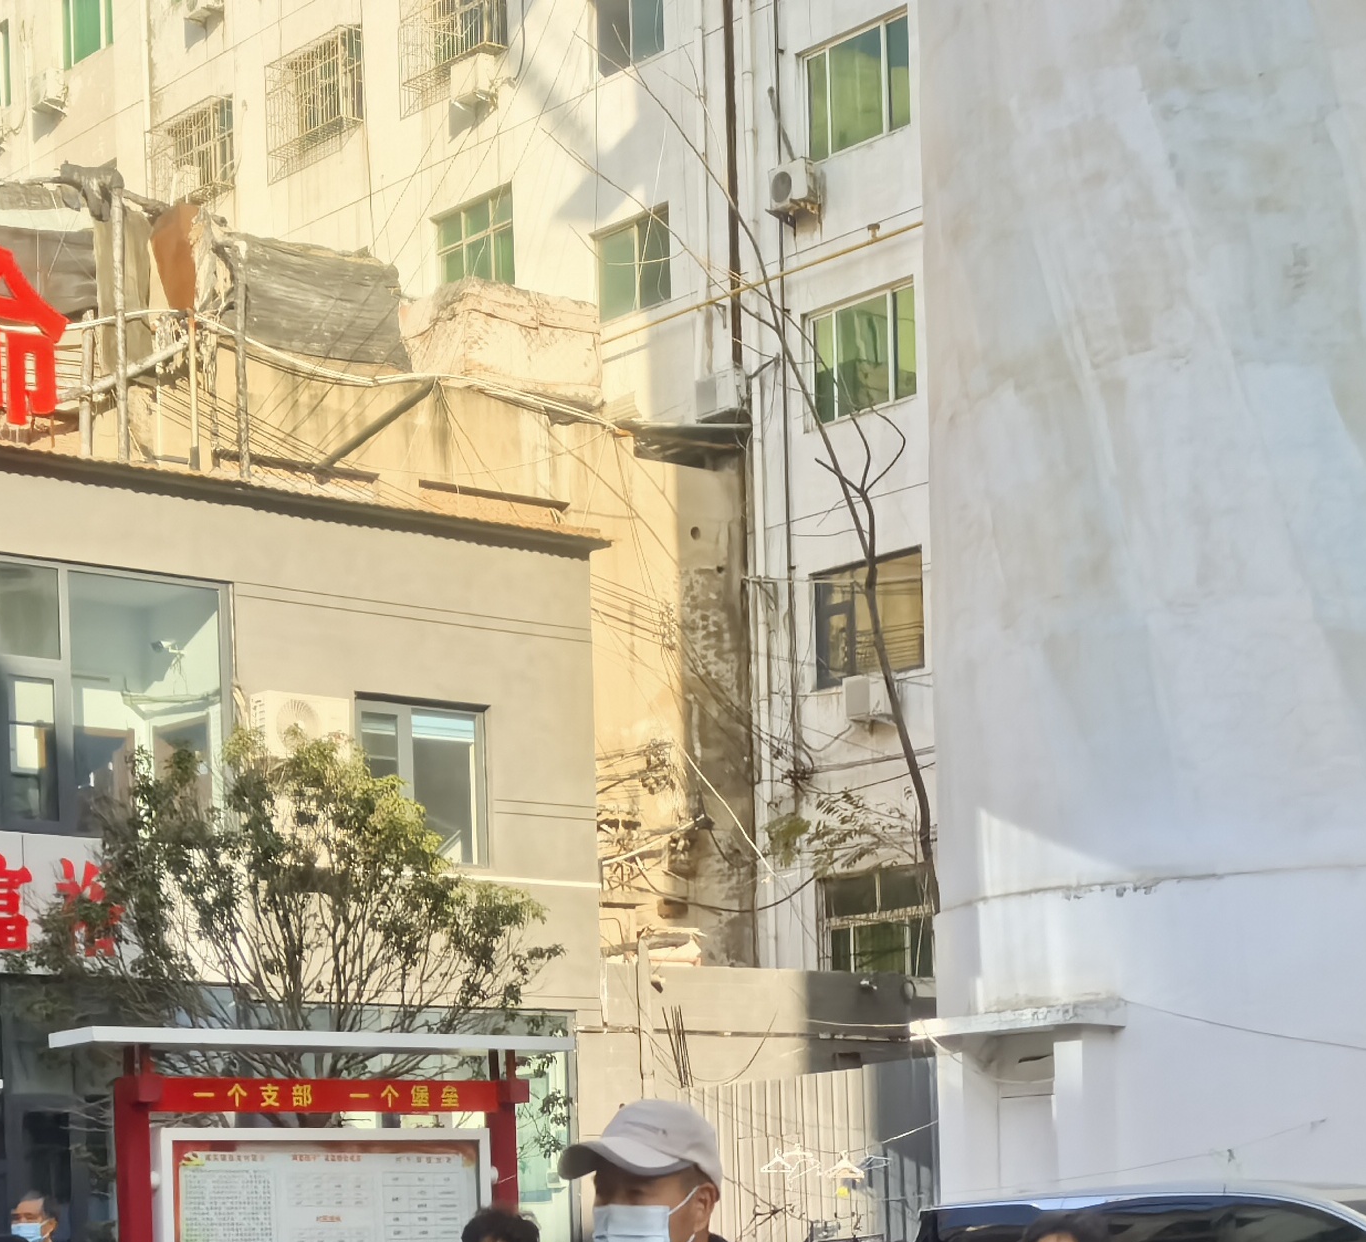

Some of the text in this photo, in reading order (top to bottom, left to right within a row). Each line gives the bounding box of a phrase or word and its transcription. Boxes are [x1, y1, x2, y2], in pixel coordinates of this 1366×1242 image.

[193, 1083, 460, 1108] 一个支部 一个堡垒
